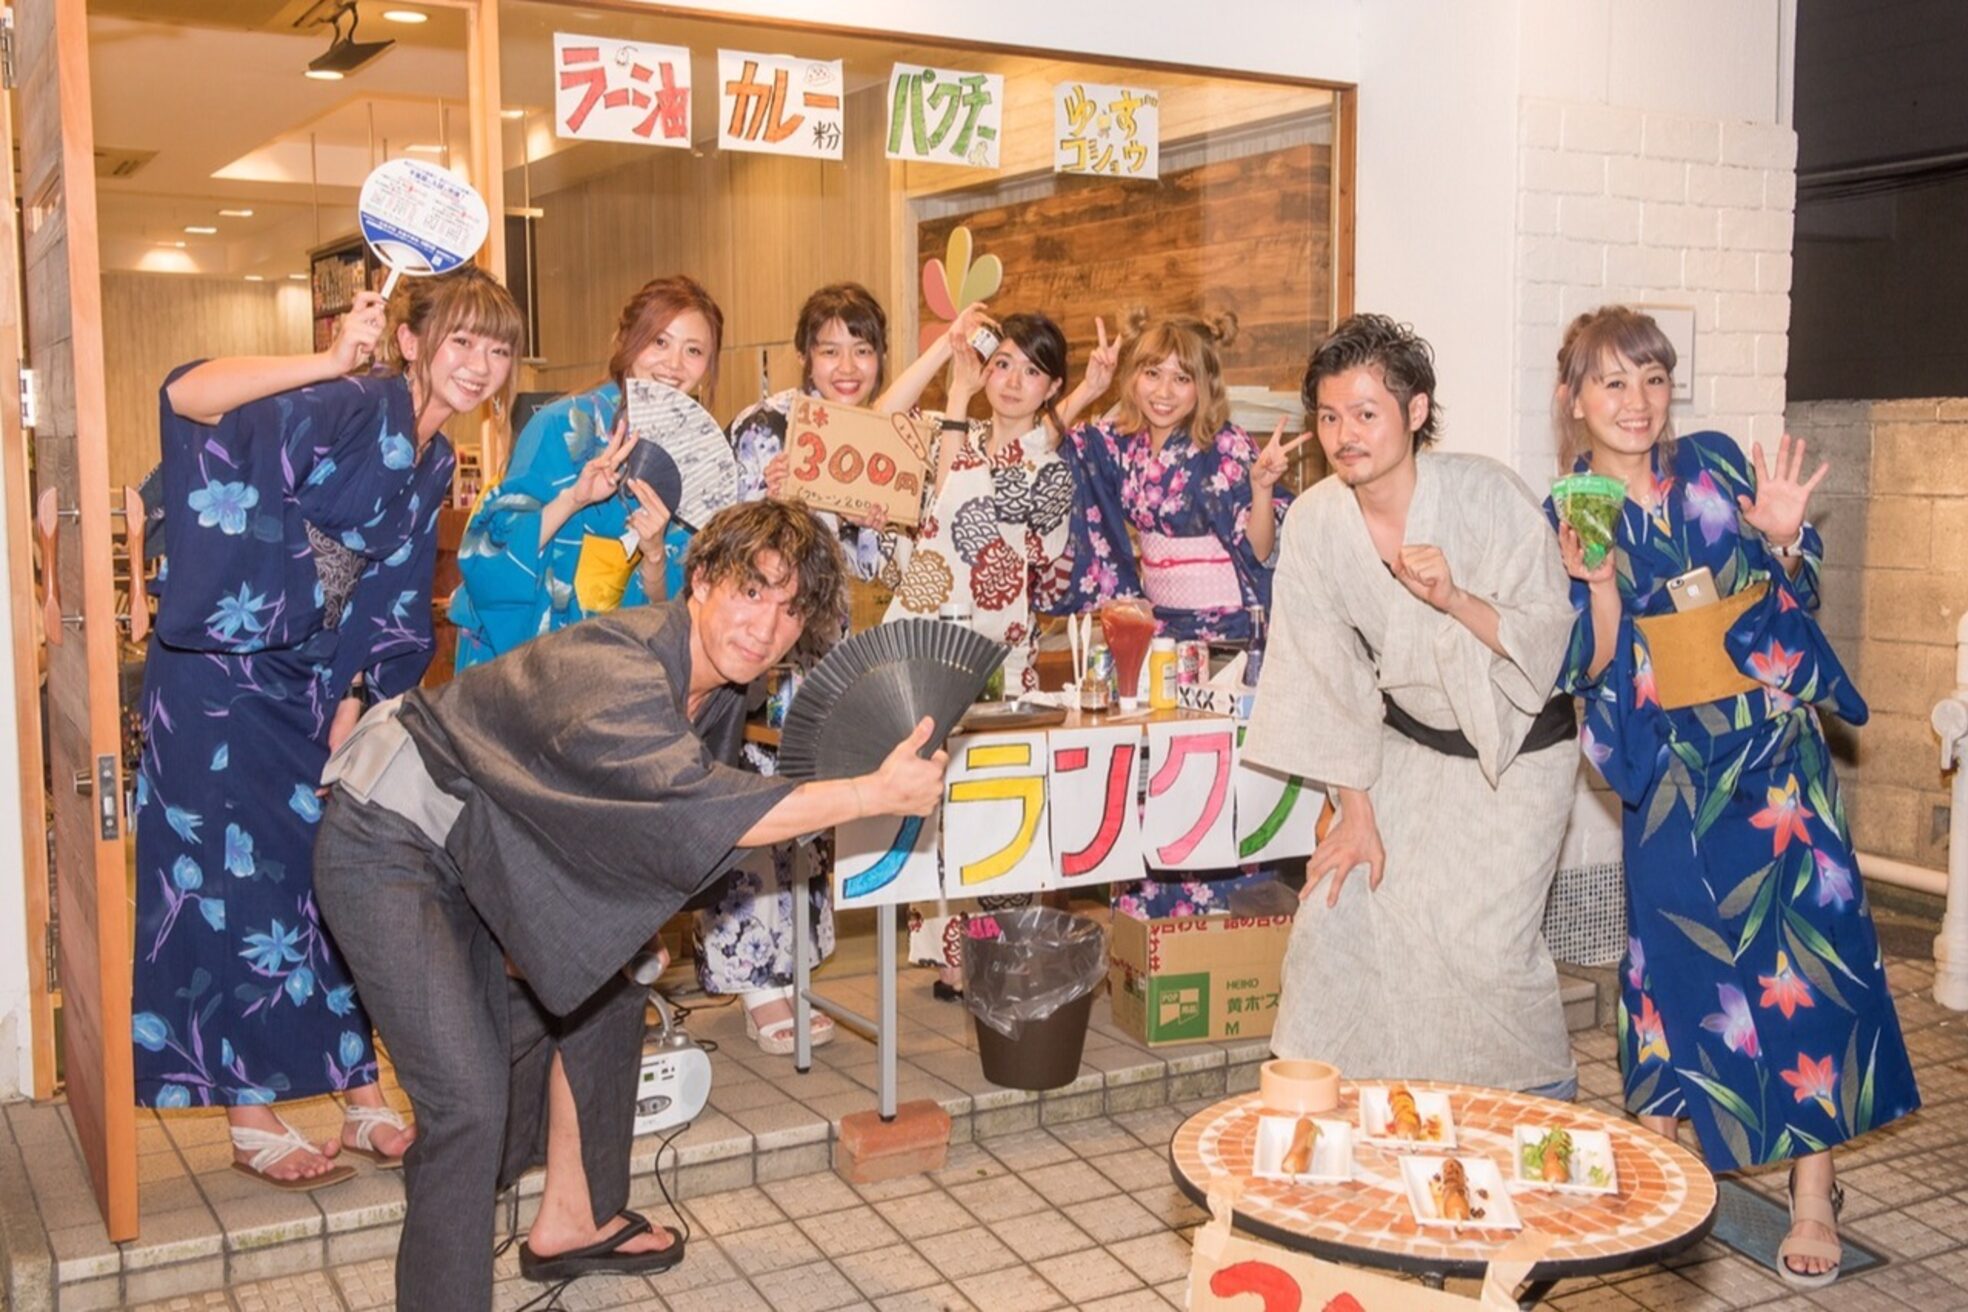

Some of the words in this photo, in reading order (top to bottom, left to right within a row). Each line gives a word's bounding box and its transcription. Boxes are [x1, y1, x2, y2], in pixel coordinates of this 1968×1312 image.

[559, 46, 690, 140] ラー油
[725, 59, 840, 144] カレー
[887, 68, 997, 157] パクチー
[1063, 84, 1158, 139] ゆず
[811, 119, 842, 151] 粉
[1060, 137, 1149, 174] コショウ
[793, 431, 919, 497] 300円
[1226, 978, 1260, 991] HEIKO
[1225, 1020, 1240, 1036] M
